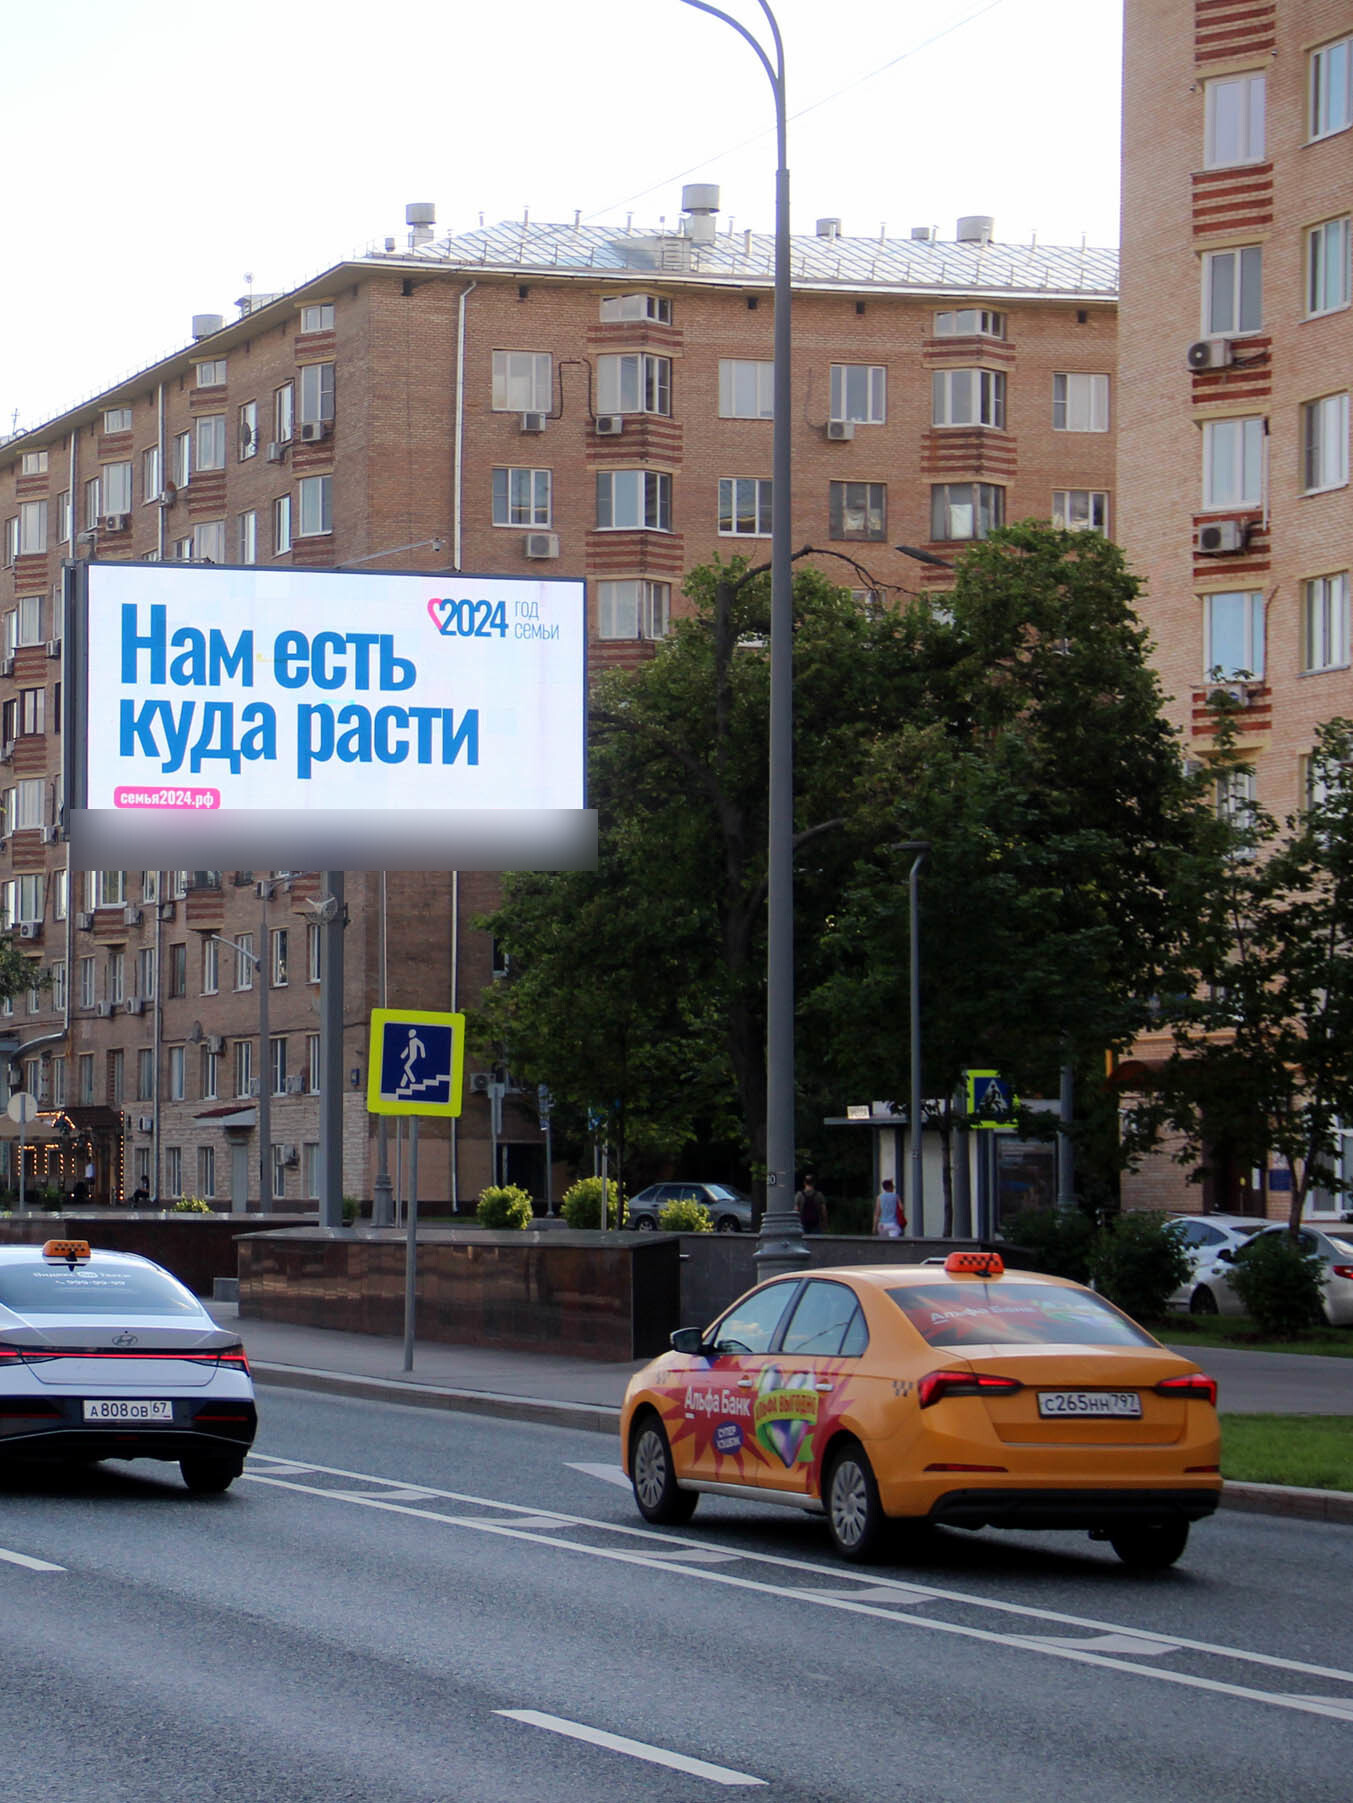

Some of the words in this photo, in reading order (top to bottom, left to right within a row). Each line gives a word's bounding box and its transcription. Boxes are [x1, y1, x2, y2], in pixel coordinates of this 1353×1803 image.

[439, 598, 510, 638] 2024
[515, 600, 540, 621] год
[514, 622, 560, 640] семьи
[120, 602, 254, 688] Нам
[273, 629, 417, 692] есть
[119, 698, 277, 775] куда
[297, 702, 479, 780] расти
[120, 790, 215, 809] семья2024.рф
[90, 1402, 149, 1418] А808ОВ
[152, 1401, 167, 1414] 67
[684, 1385, 720, 1419] Альфа
[721, 1389, 751, 1417] Банк
[1044, 1394, 1110, 1412] С265НН
[1111, 1394, 1135, 1408] 797
